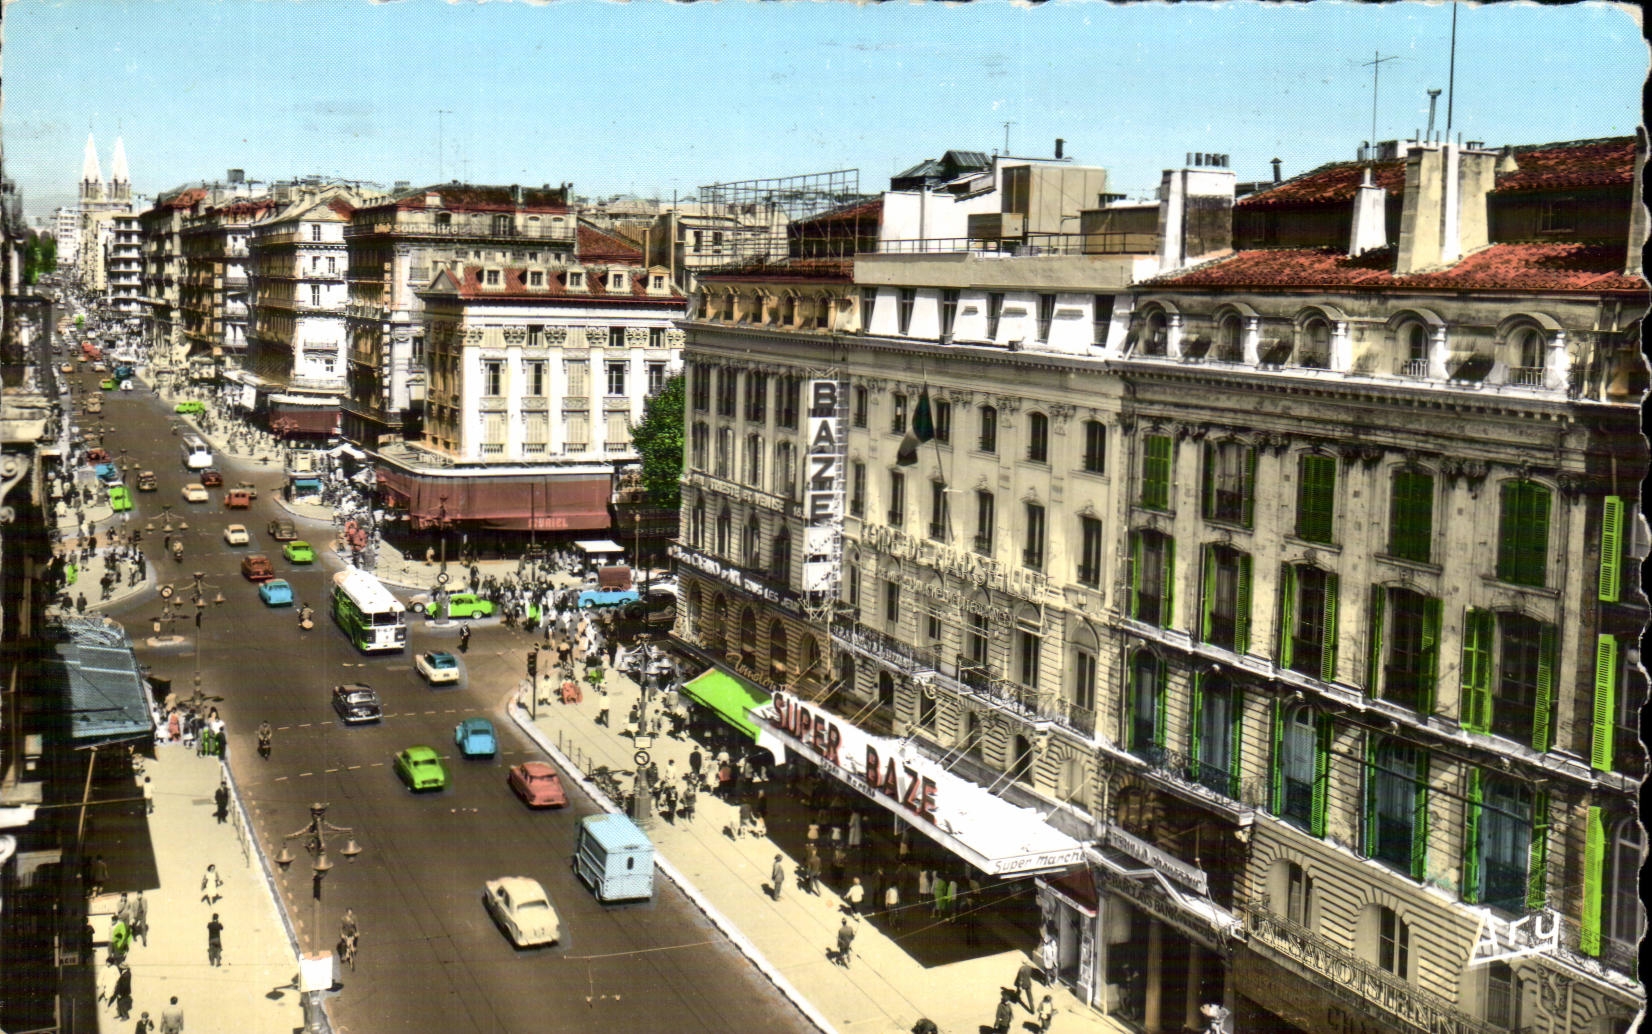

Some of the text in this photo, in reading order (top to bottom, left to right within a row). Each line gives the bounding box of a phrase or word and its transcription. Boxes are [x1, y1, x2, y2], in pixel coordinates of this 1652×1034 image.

[810, 381, 837, 519] BAZE
[934, 545, 1047, 604] MARSEILLE
[771, 692, 937, 826] SUPER BAZE
[993, 858, 1032, 874] Super
